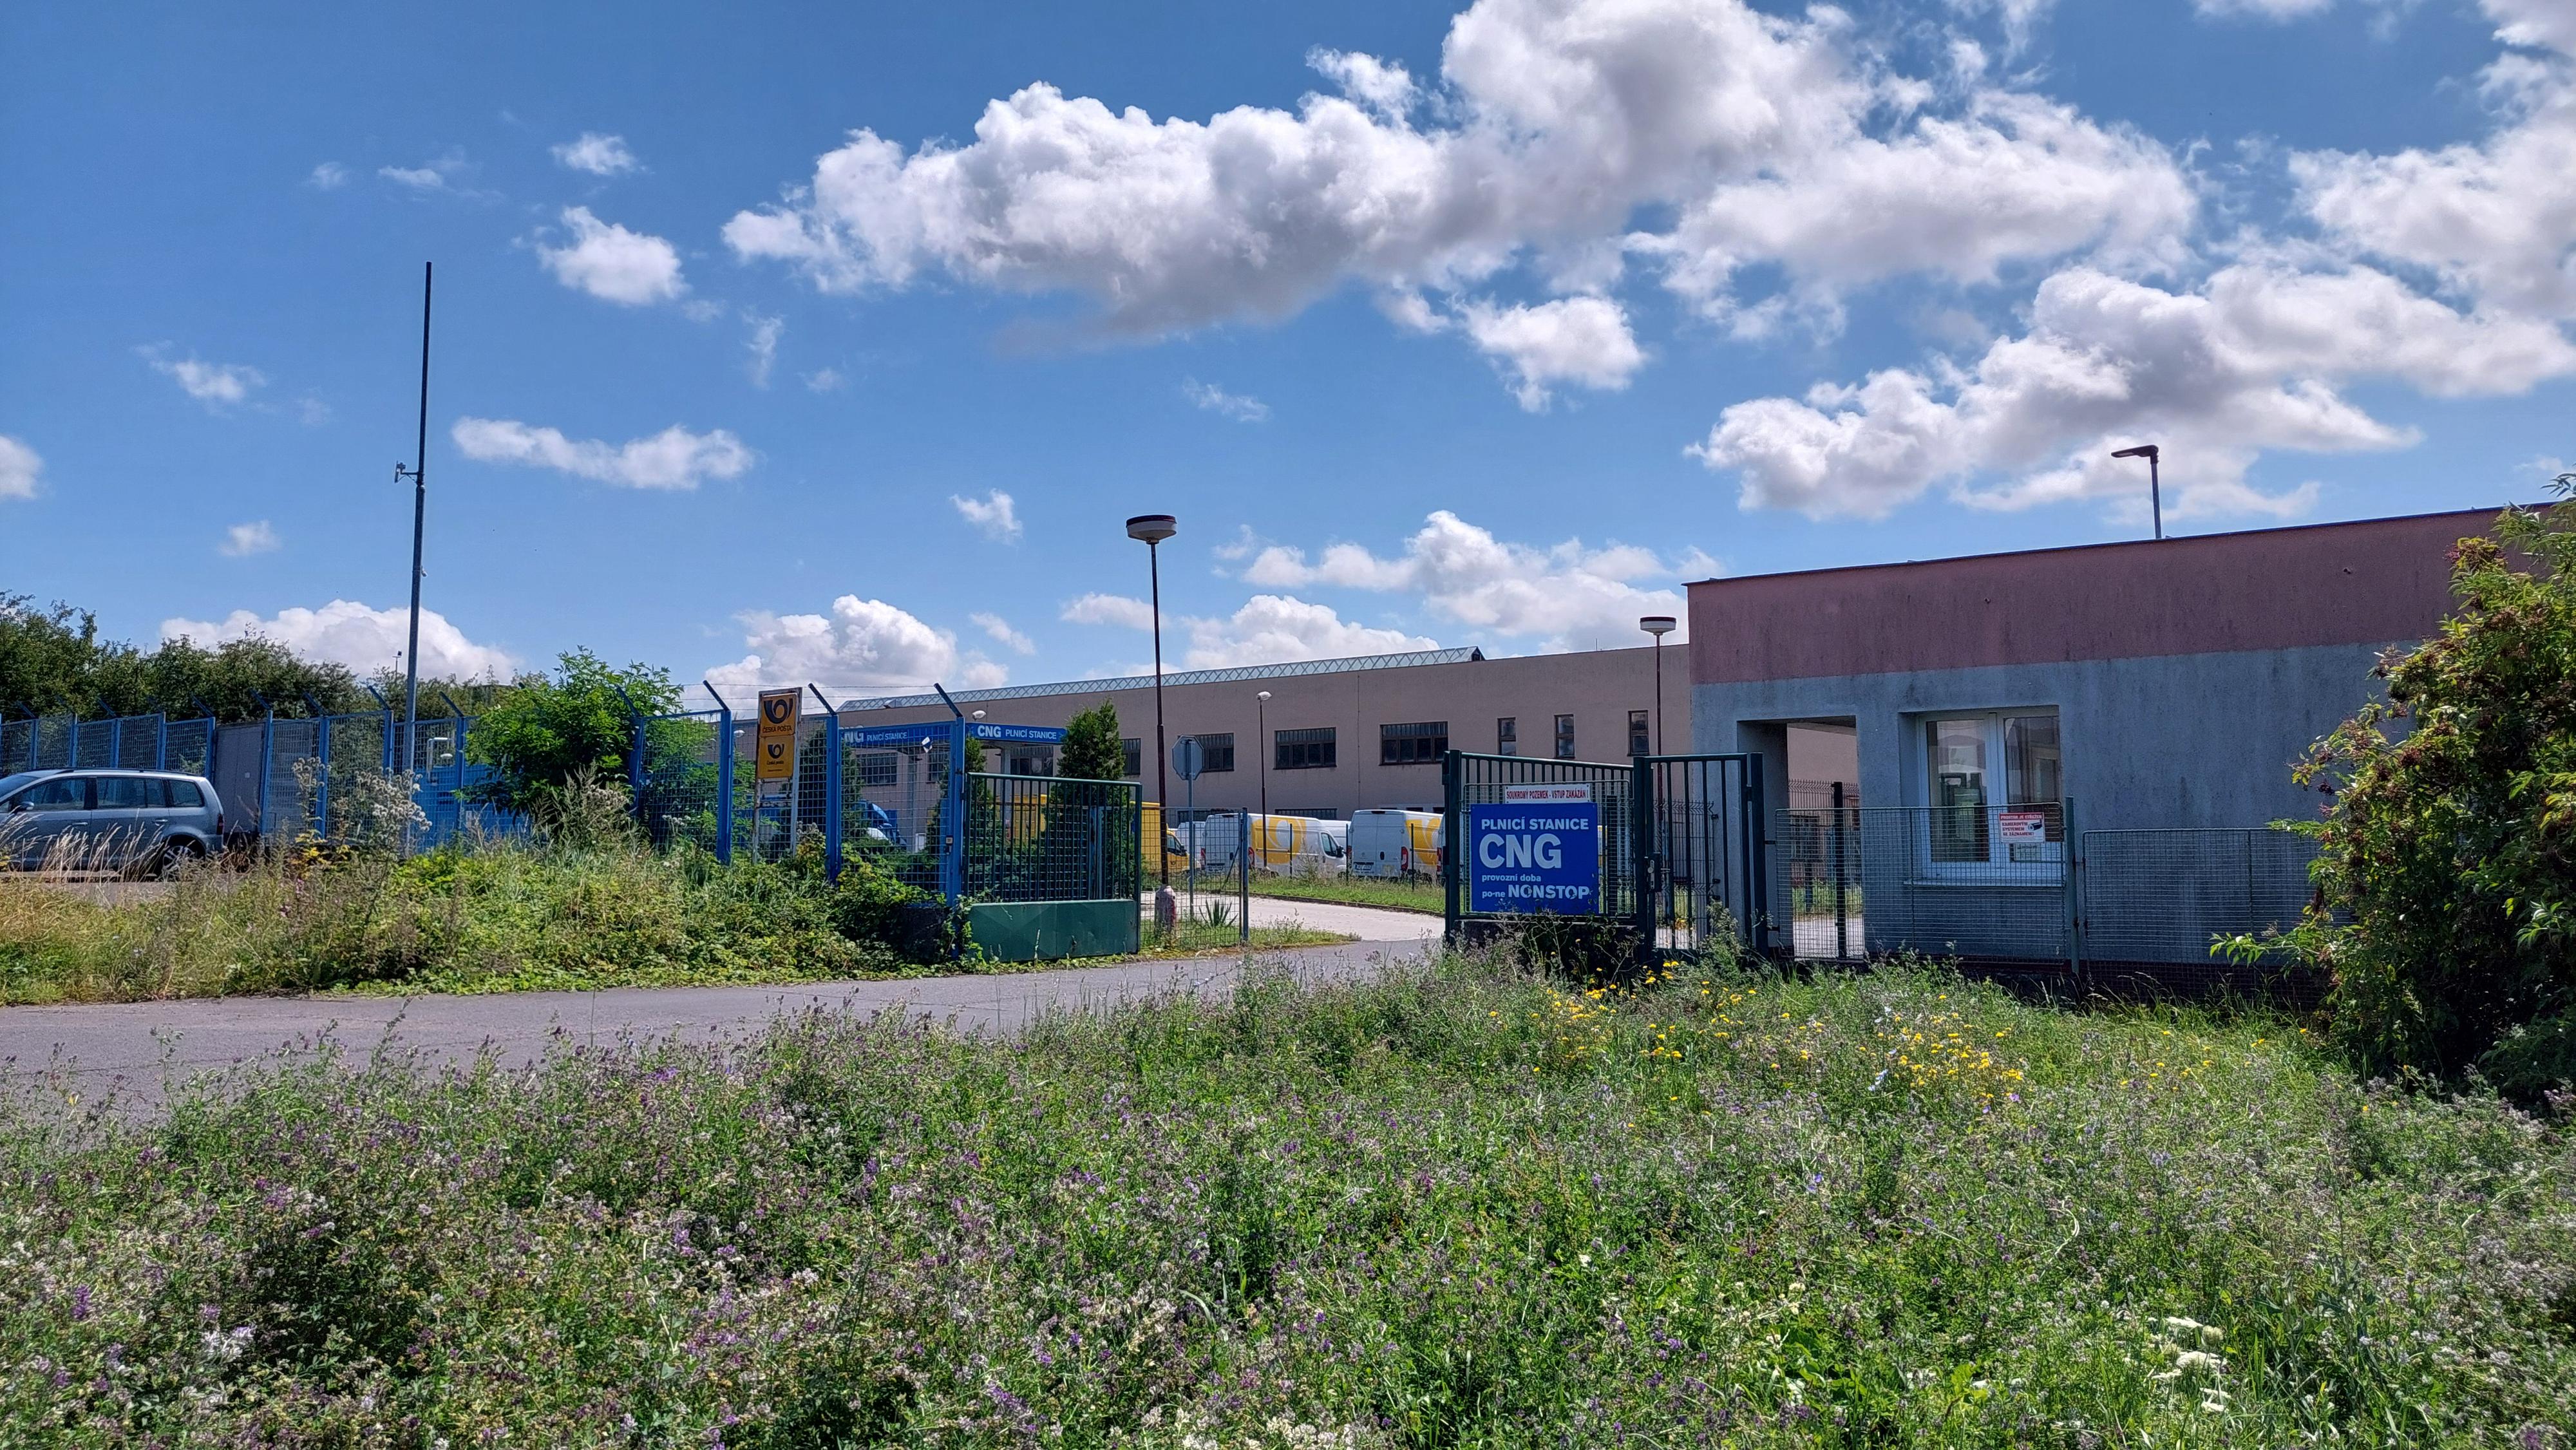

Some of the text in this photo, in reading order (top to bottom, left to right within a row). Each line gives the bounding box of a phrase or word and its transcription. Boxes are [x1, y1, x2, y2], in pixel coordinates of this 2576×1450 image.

[977, 725, 1057, 739] CNG PLNICÍ STANICE
[1506, 788, 1529, 799] SOUKROMÝ
[1530, 790, 1549, 799] POZEMEK
[1551, 789, 1565, 798] VSTUP
[1481, 816, 1589, 830] PLNICÍ STANICE
[1479, 833, 1562, 869] CNG
[1482, 874, 1542, 883] provozní doba
[1482, 884, 1590, 899] po-ne NONSTOP
